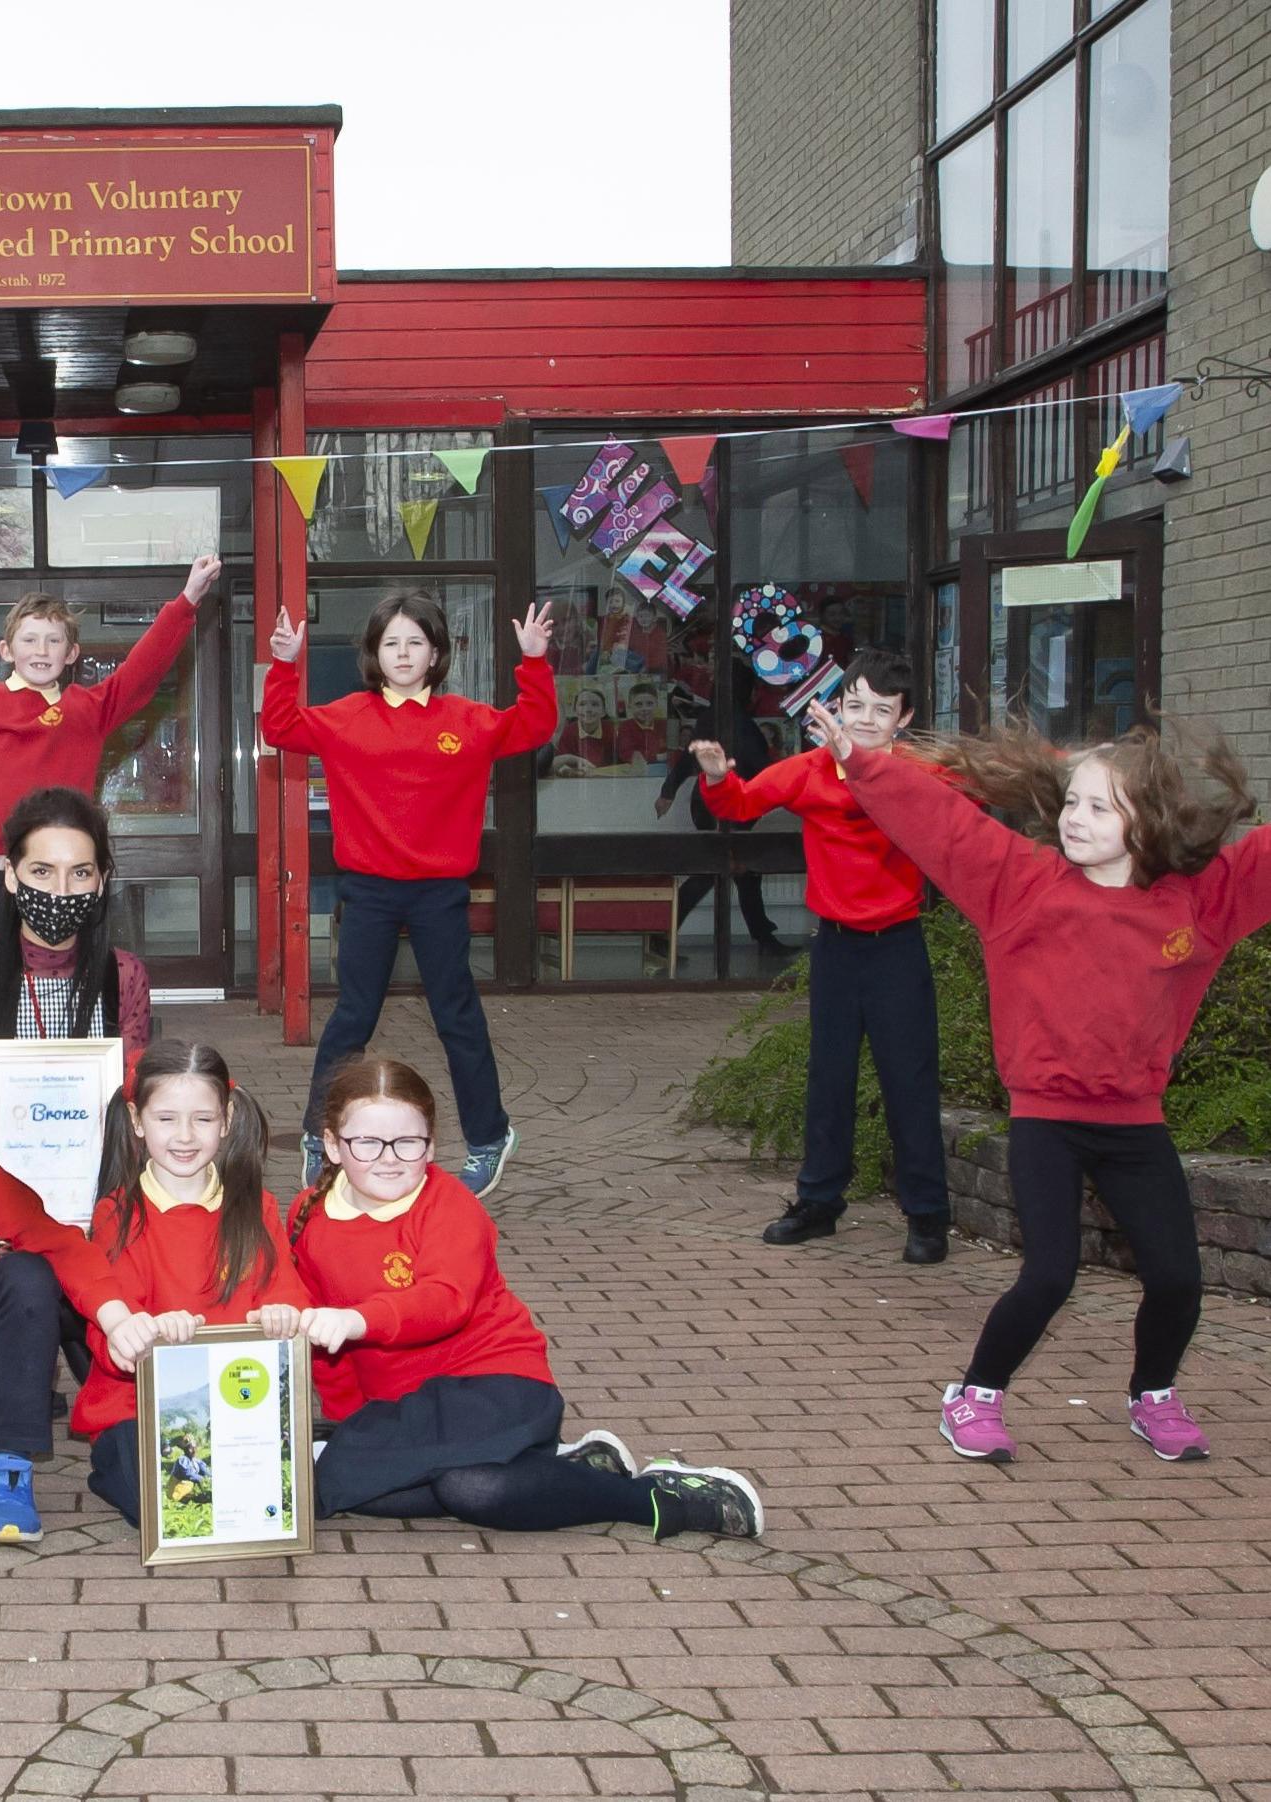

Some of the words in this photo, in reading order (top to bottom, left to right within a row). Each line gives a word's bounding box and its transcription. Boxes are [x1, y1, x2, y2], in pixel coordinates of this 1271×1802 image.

[87, 180, 243, 216] Voluntary
[49, 228, 176, 261] Primary
[190, 224, 295, 256] School
[38, 272, 66, 287] 1972
[29, 1103, 89, 1121] Bronze
